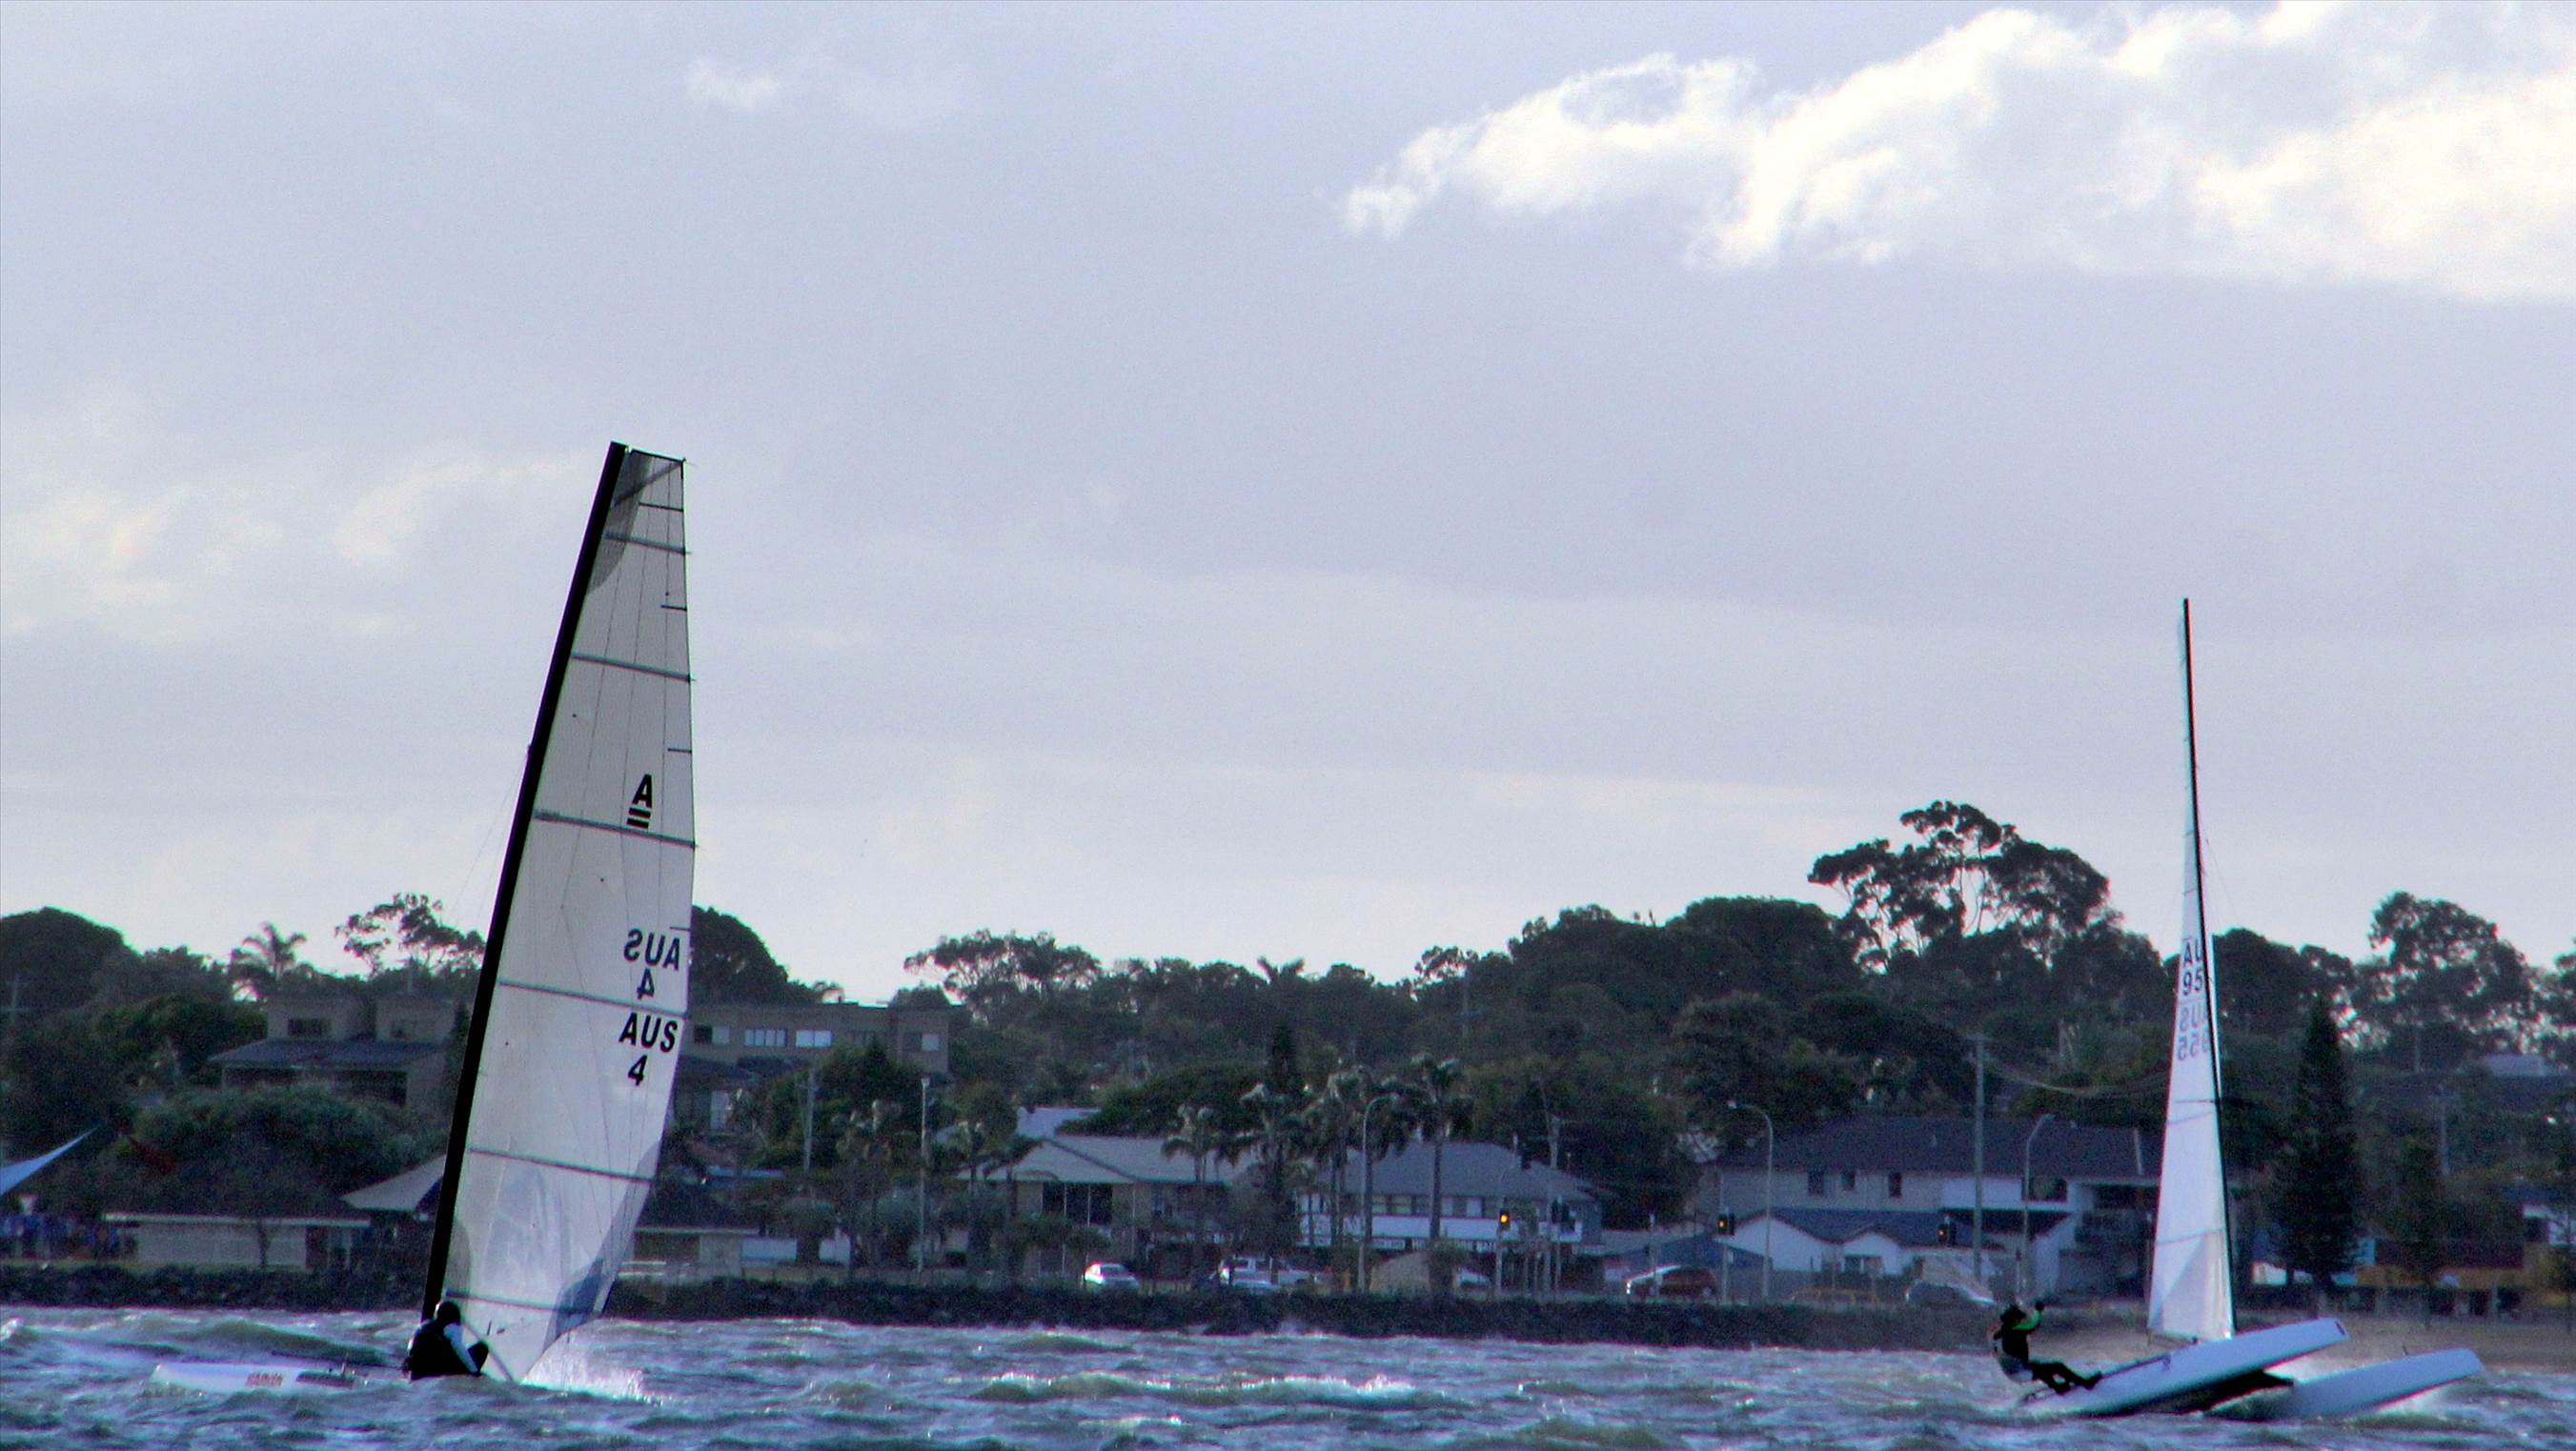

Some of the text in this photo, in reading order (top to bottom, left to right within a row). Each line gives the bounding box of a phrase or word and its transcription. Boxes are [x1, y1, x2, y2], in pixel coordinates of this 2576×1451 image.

[632, 774, 653, 809] A
[619, 1012, 678, 1053] AUS
[627, 1054, 648, 1086] 4
